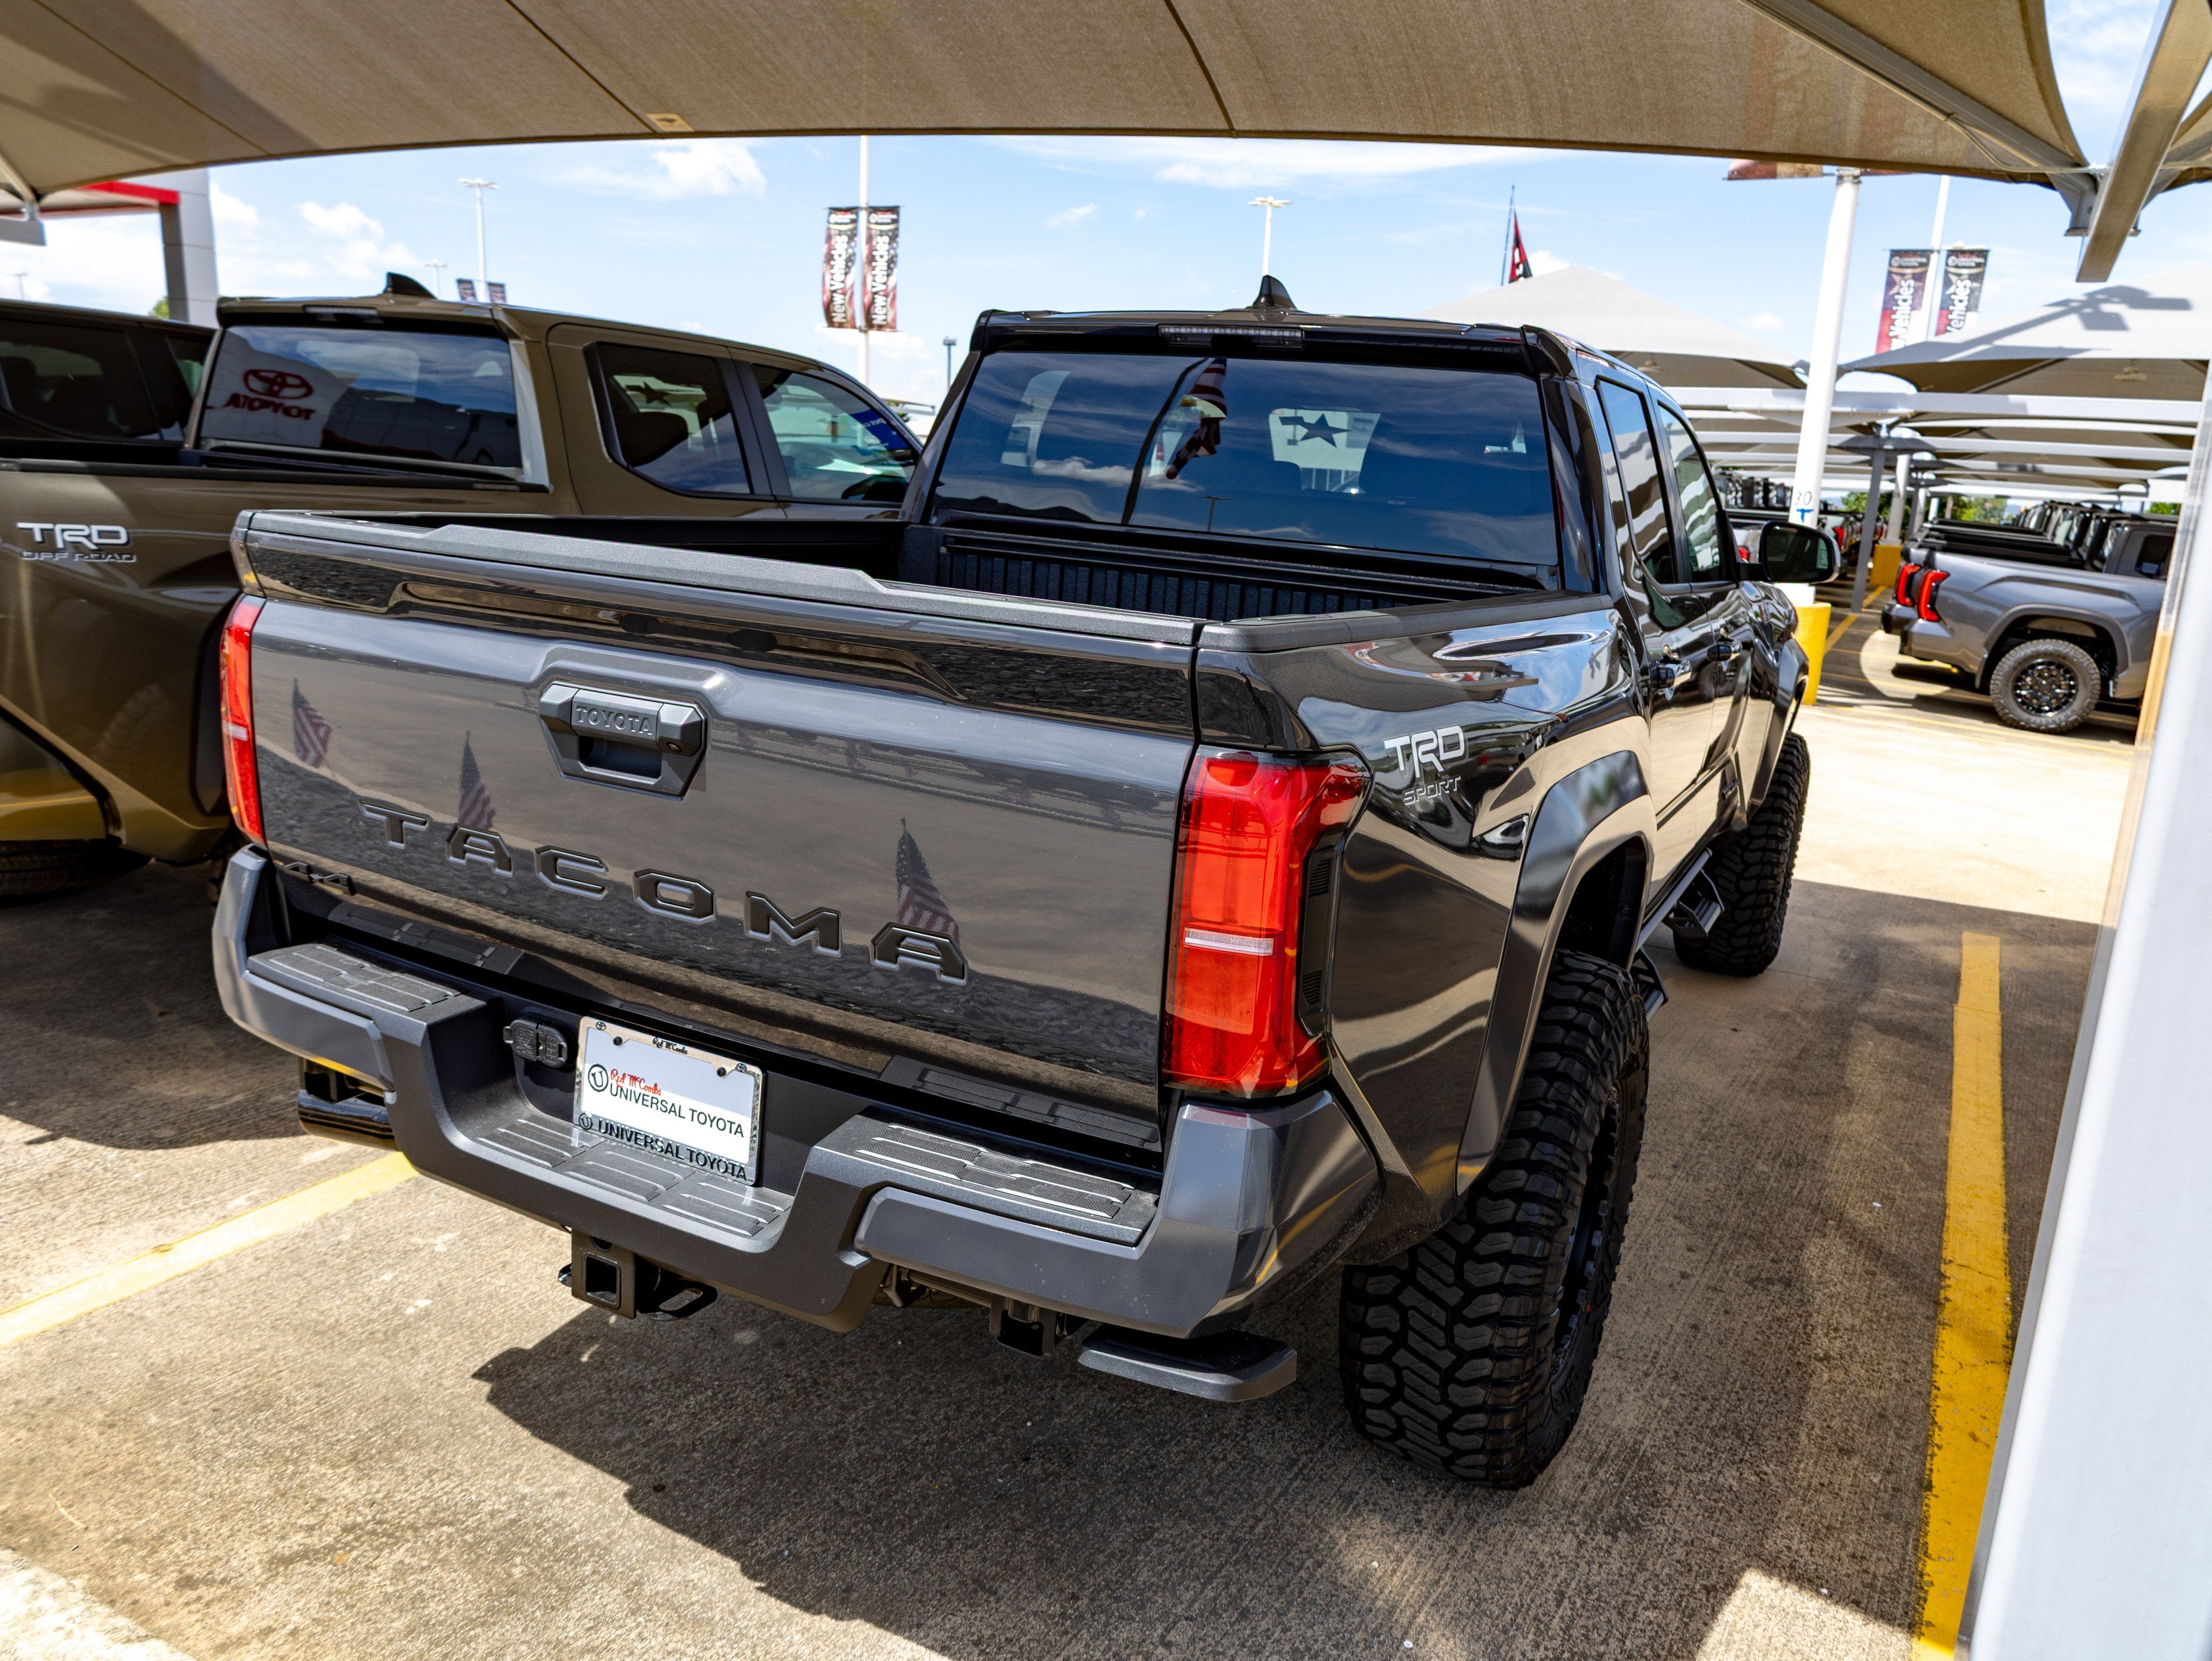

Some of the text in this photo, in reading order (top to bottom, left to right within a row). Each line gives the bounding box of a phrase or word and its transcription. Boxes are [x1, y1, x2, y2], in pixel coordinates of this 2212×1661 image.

[830, 235, 848, 292] Vehicles
[872, 236, 889, 292] Vehicles
[831, 293, 847, 323] New
[872, 294, 887, 325] New
[1889, 279, 1915, 336] Vehicles
[1794, 491, 1812, 505] 30
[17, 522, 128, 549] TRD
[21, 551, 137, 562] OFF ROAD
[576, 705, 653, 735] TOYOTA
[1383, 725, 1466, 778] TRD
[1403, 775, 1461, 806] SPORT
[357, 799, 969, 986] TACOMA
[652, 1036, 664, 1048] Red
[611, 1068, 661, 1096] Red McCombs
[610, 1083, 744, 1138] UNIVERSAL TOYOTA
[597, 1118, 748, 1181] UNIVERSAL TOYOTA
